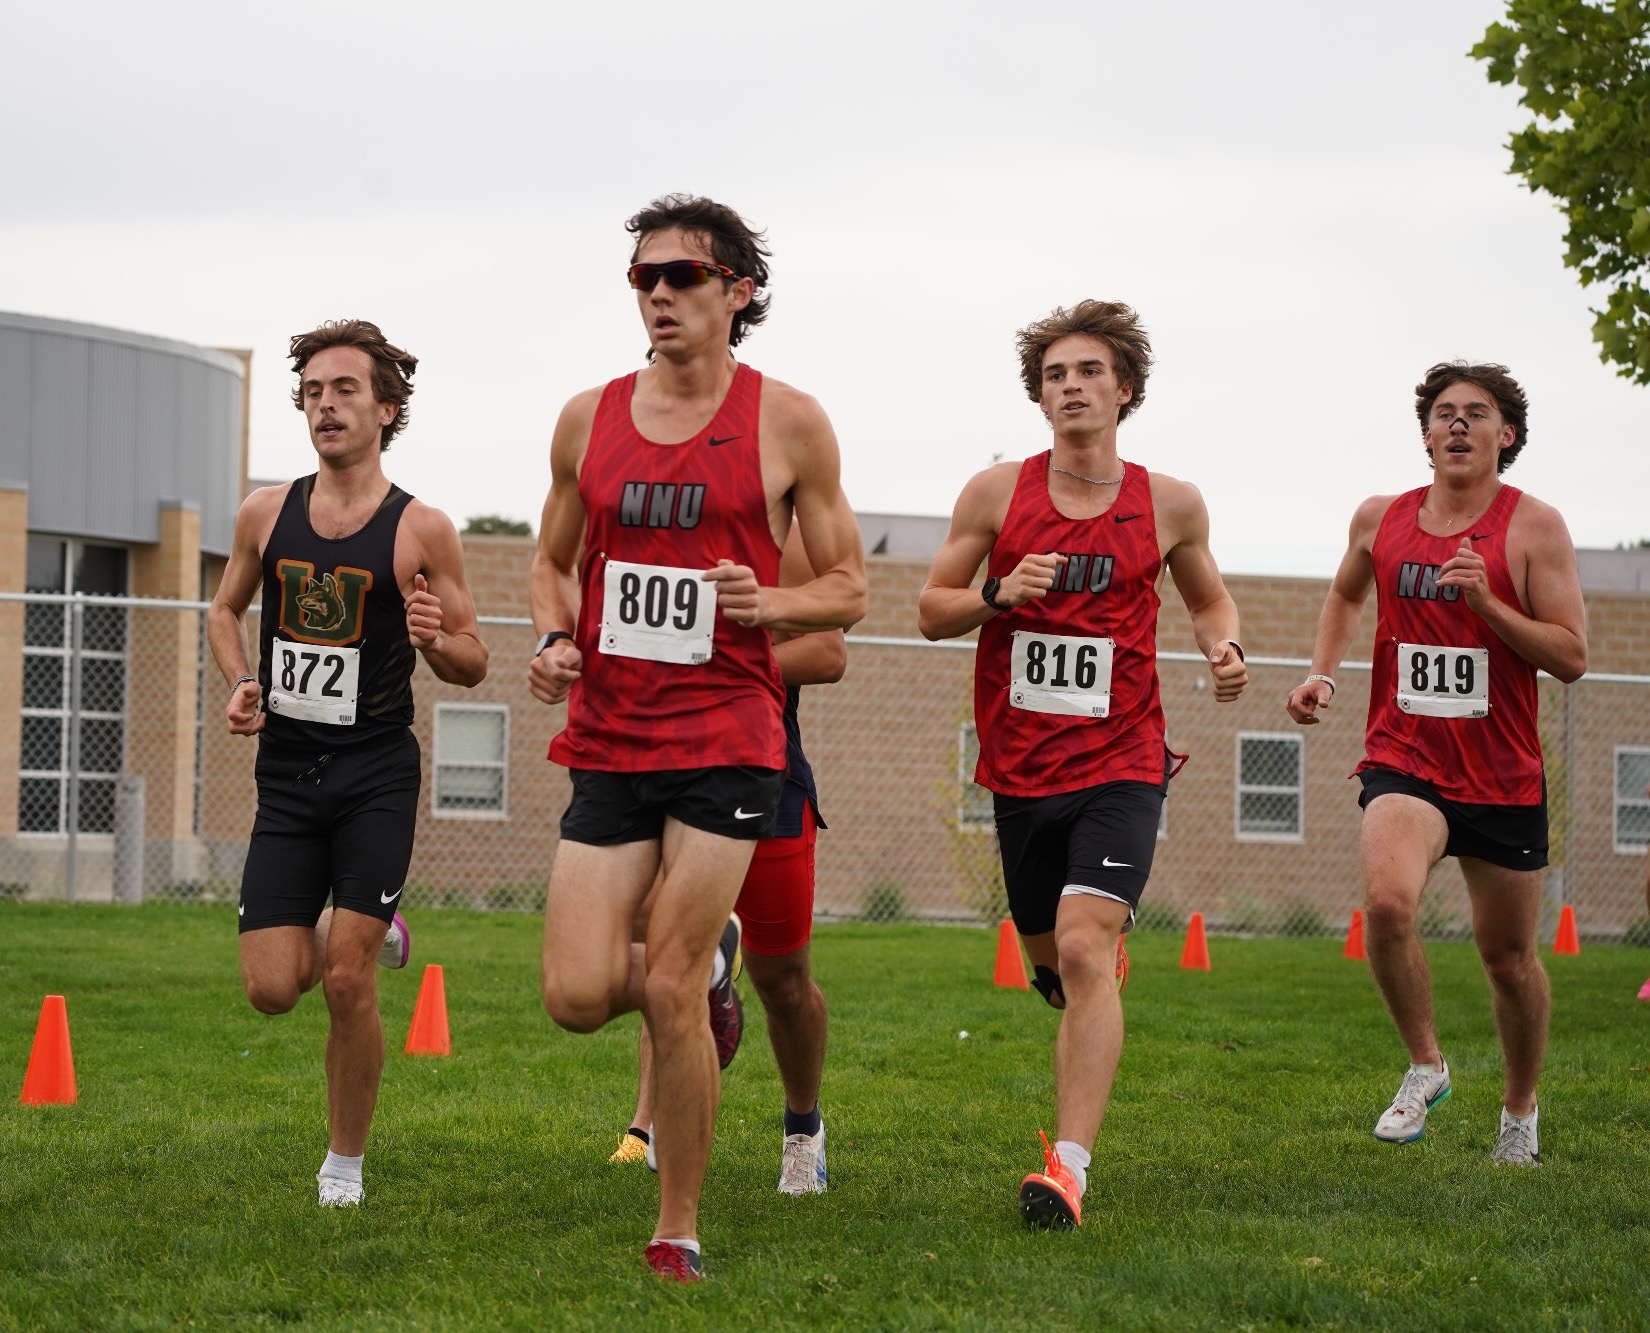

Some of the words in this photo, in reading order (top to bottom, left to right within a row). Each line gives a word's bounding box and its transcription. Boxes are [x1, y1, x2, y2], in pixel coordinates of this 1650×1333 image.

[619, 481, 707, 530] NNU
[276, 559, 373, 647] U
[619, 572, 699, 631] 809
[281, 649, 345, 698] 872
[1026, 640, 1098, 689] 816
[1411, 651, 1475, 695] 819
